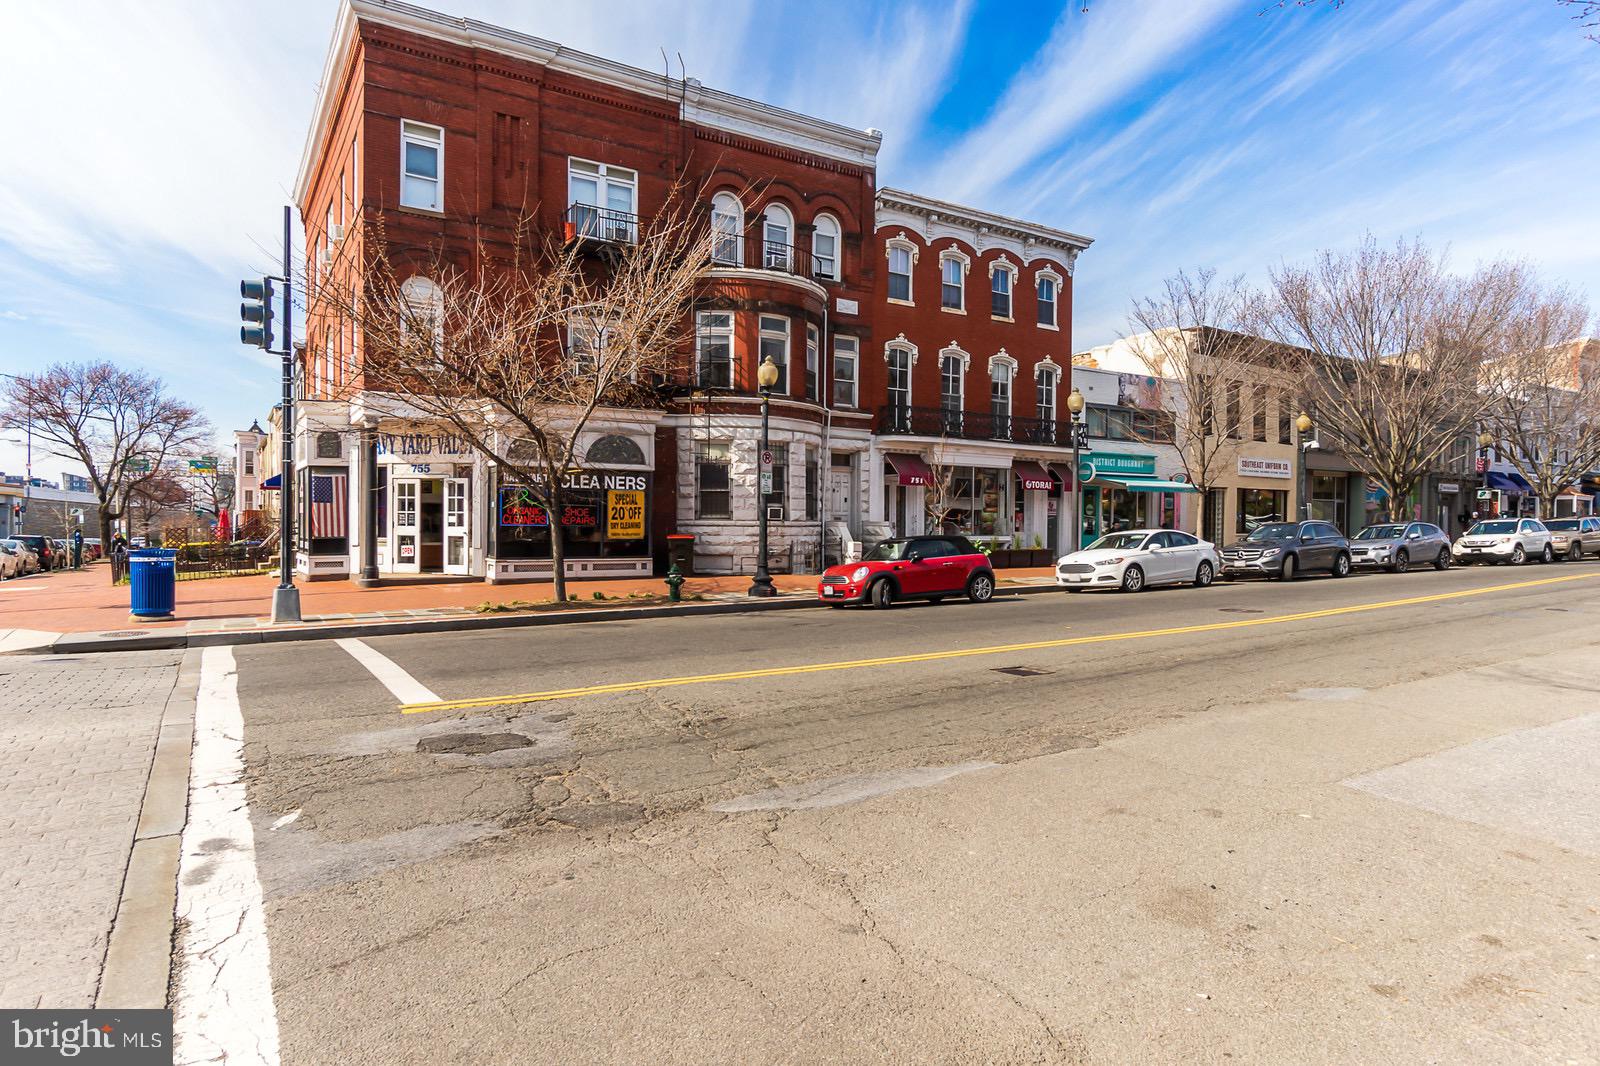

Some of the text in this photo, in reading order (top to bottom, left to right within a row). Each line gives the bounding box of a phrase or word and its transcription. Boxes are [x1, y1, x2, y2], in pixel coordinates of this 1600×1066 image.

[373, 433, 396, 454] AVY
[401, 433, 432, 454] YARD
[1093, 458, 1116, 467] DISTRICT
[411, 464, 430, 473] 755
[614, 493, 638, 505] SPECIAL
[506, 507, 543, 516] ORGANIC
[565, 508, 590, 517] SHOE
[629, 506, 642, 520] OFF
[502, 514, 547, 525] CLEANERS
[620, 521, 641, 529] CLEANING
